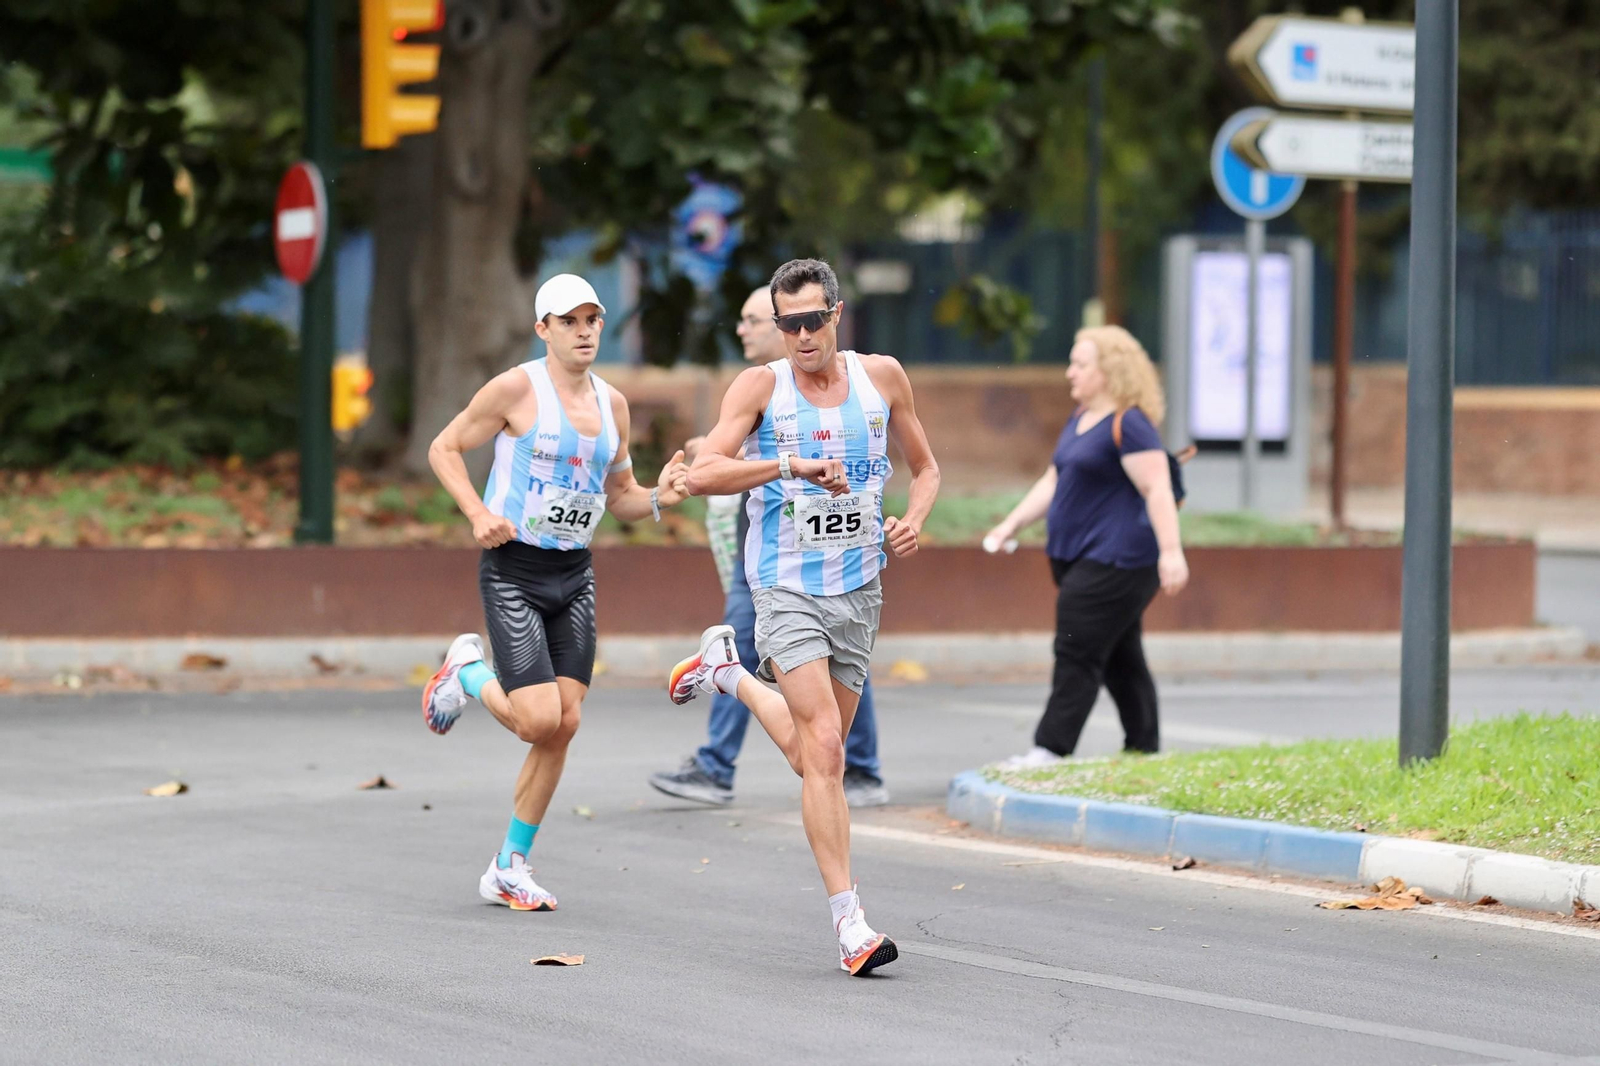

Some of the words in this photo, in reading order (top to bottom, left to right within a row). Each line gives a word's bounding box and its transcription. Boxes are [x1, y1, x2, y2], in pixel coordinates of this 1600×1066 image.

[774, 413, 797, 422] vive
[539, 433, 560, 441] vive
[548, 505, 592, 529] 344
[806, 512, 861, 535] 125
